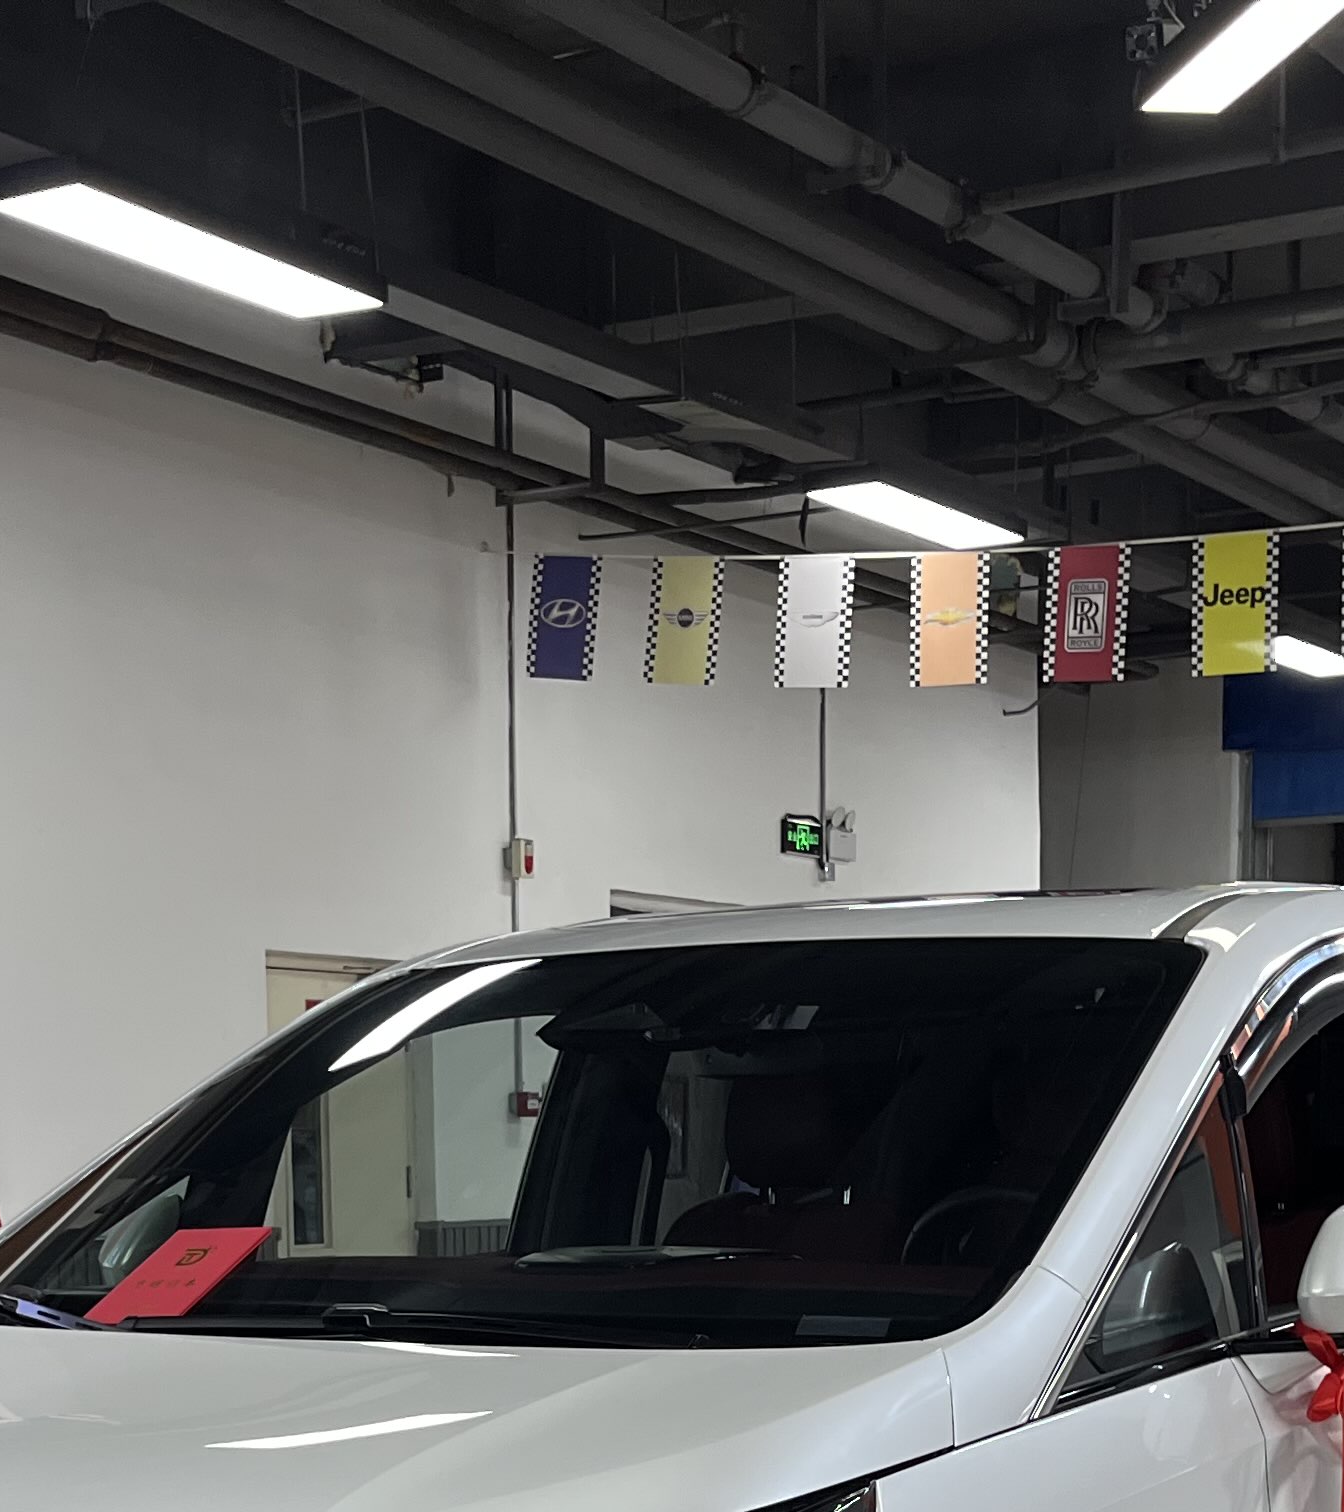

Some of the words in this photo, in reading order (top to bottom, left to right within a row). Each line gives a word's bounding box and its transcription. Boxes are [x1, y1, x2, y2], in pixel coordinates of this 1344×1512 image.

[1073, 583, 1103, 592] ROLLS
[1202, 583, 1267, 609] Jeep
[1069, 639, 1100, 648] ROYCE
